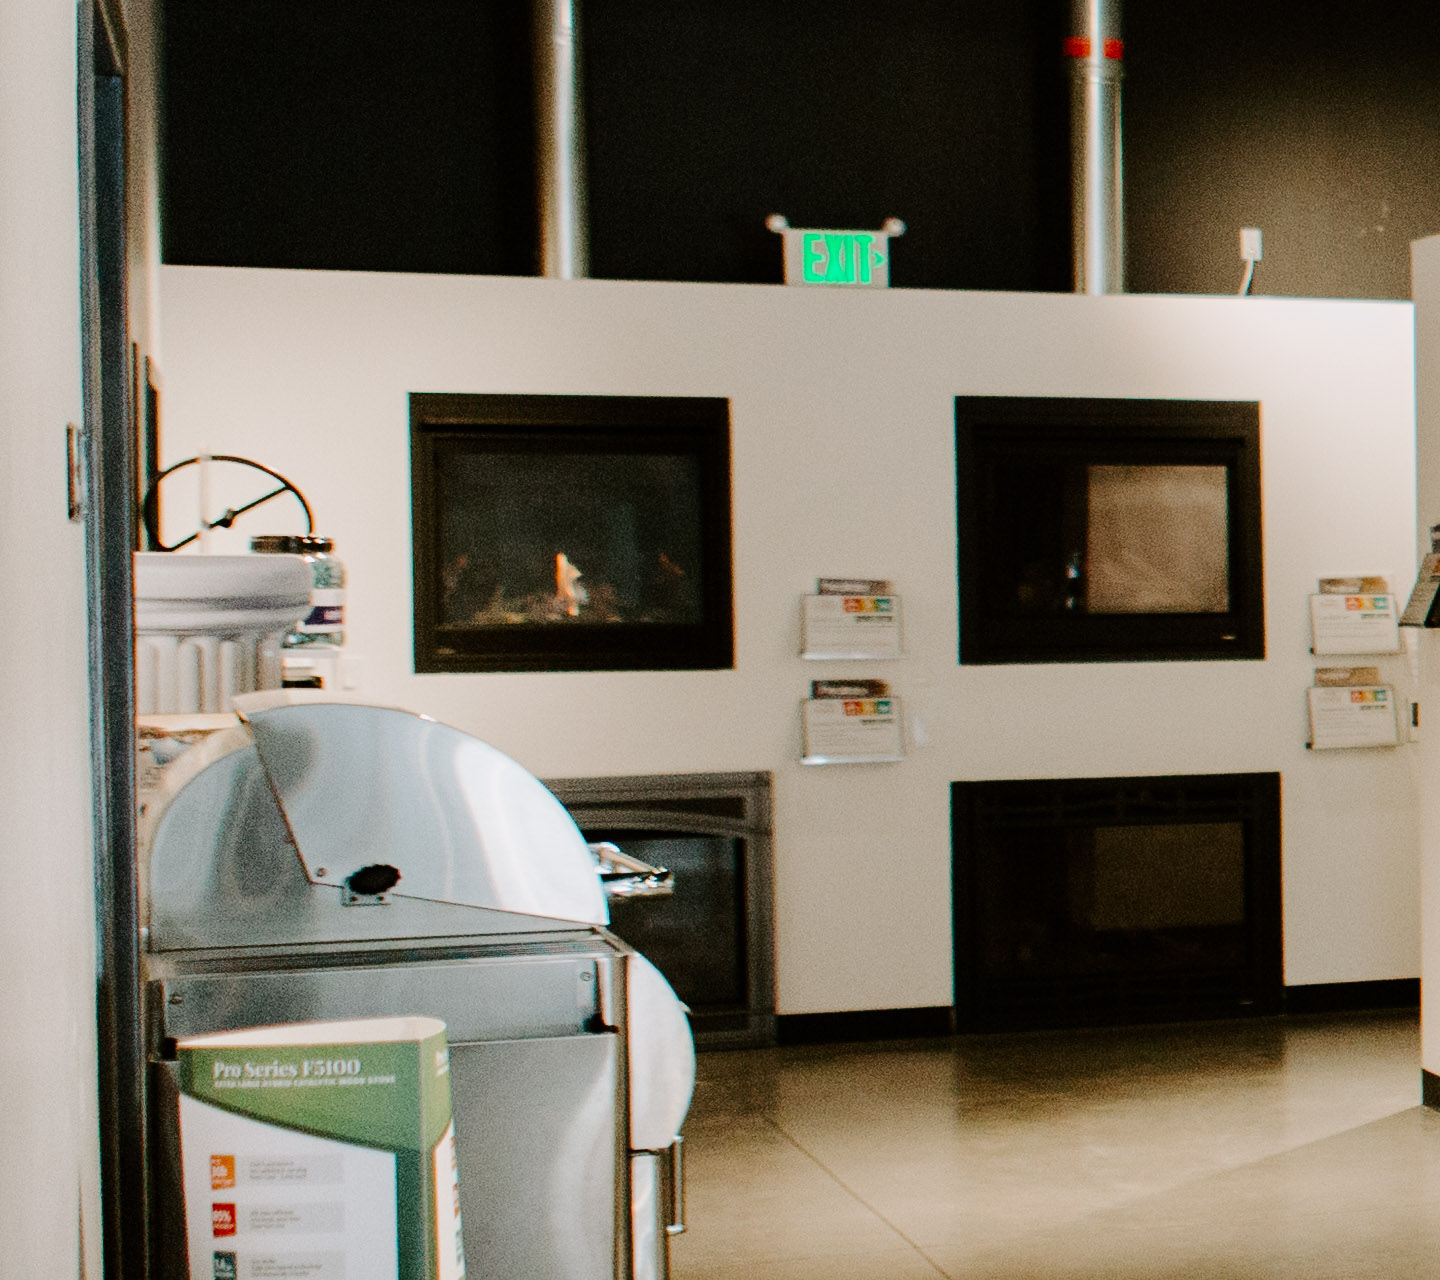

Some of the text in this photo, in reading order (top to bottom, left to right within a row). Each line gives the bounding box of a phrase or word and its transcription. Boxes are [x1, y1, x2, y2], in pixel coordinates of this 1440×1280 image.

[803, 233, 873, 284] EXIT
[213, 1058, 362, 1079] Pro Series F5100
